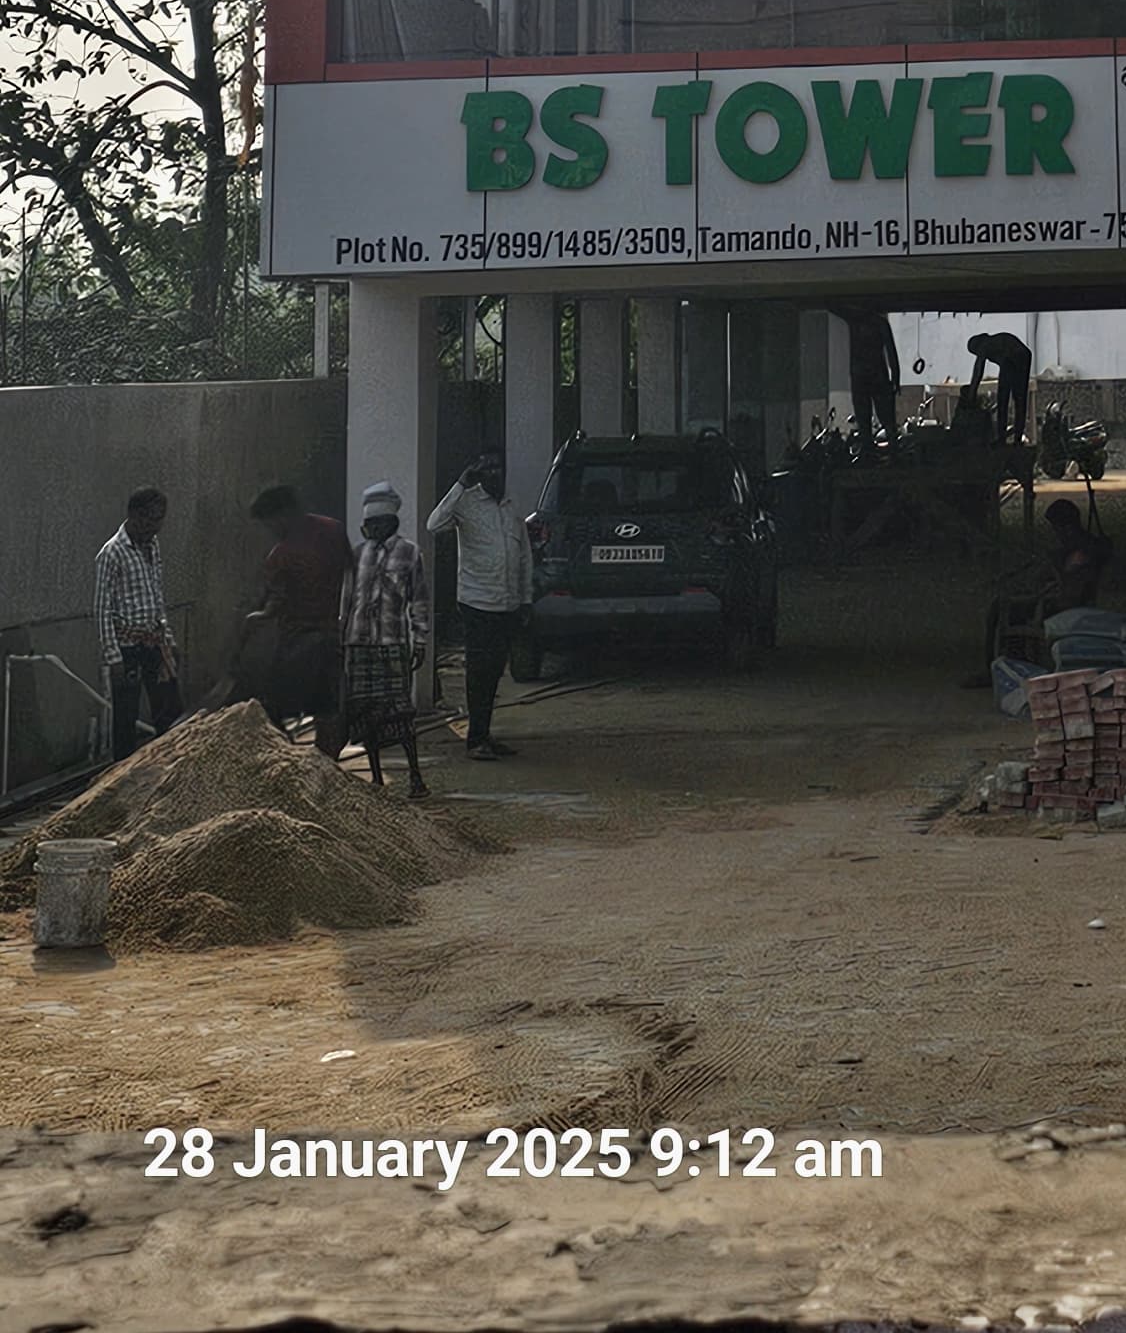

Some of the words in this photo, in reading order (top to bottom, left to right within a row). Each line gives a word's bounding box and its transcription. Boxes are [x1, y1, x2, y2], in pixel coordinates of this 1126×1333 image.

[459, 83, 609, 192] BS
[651, 71, 1076, 186] TOWER
[335, 237, 387, 265] Plot
[391, 235, 430, 263] No.
[699, 222, 820, 254] Tamando,
[825, 218, 908, 251] NH-16,
